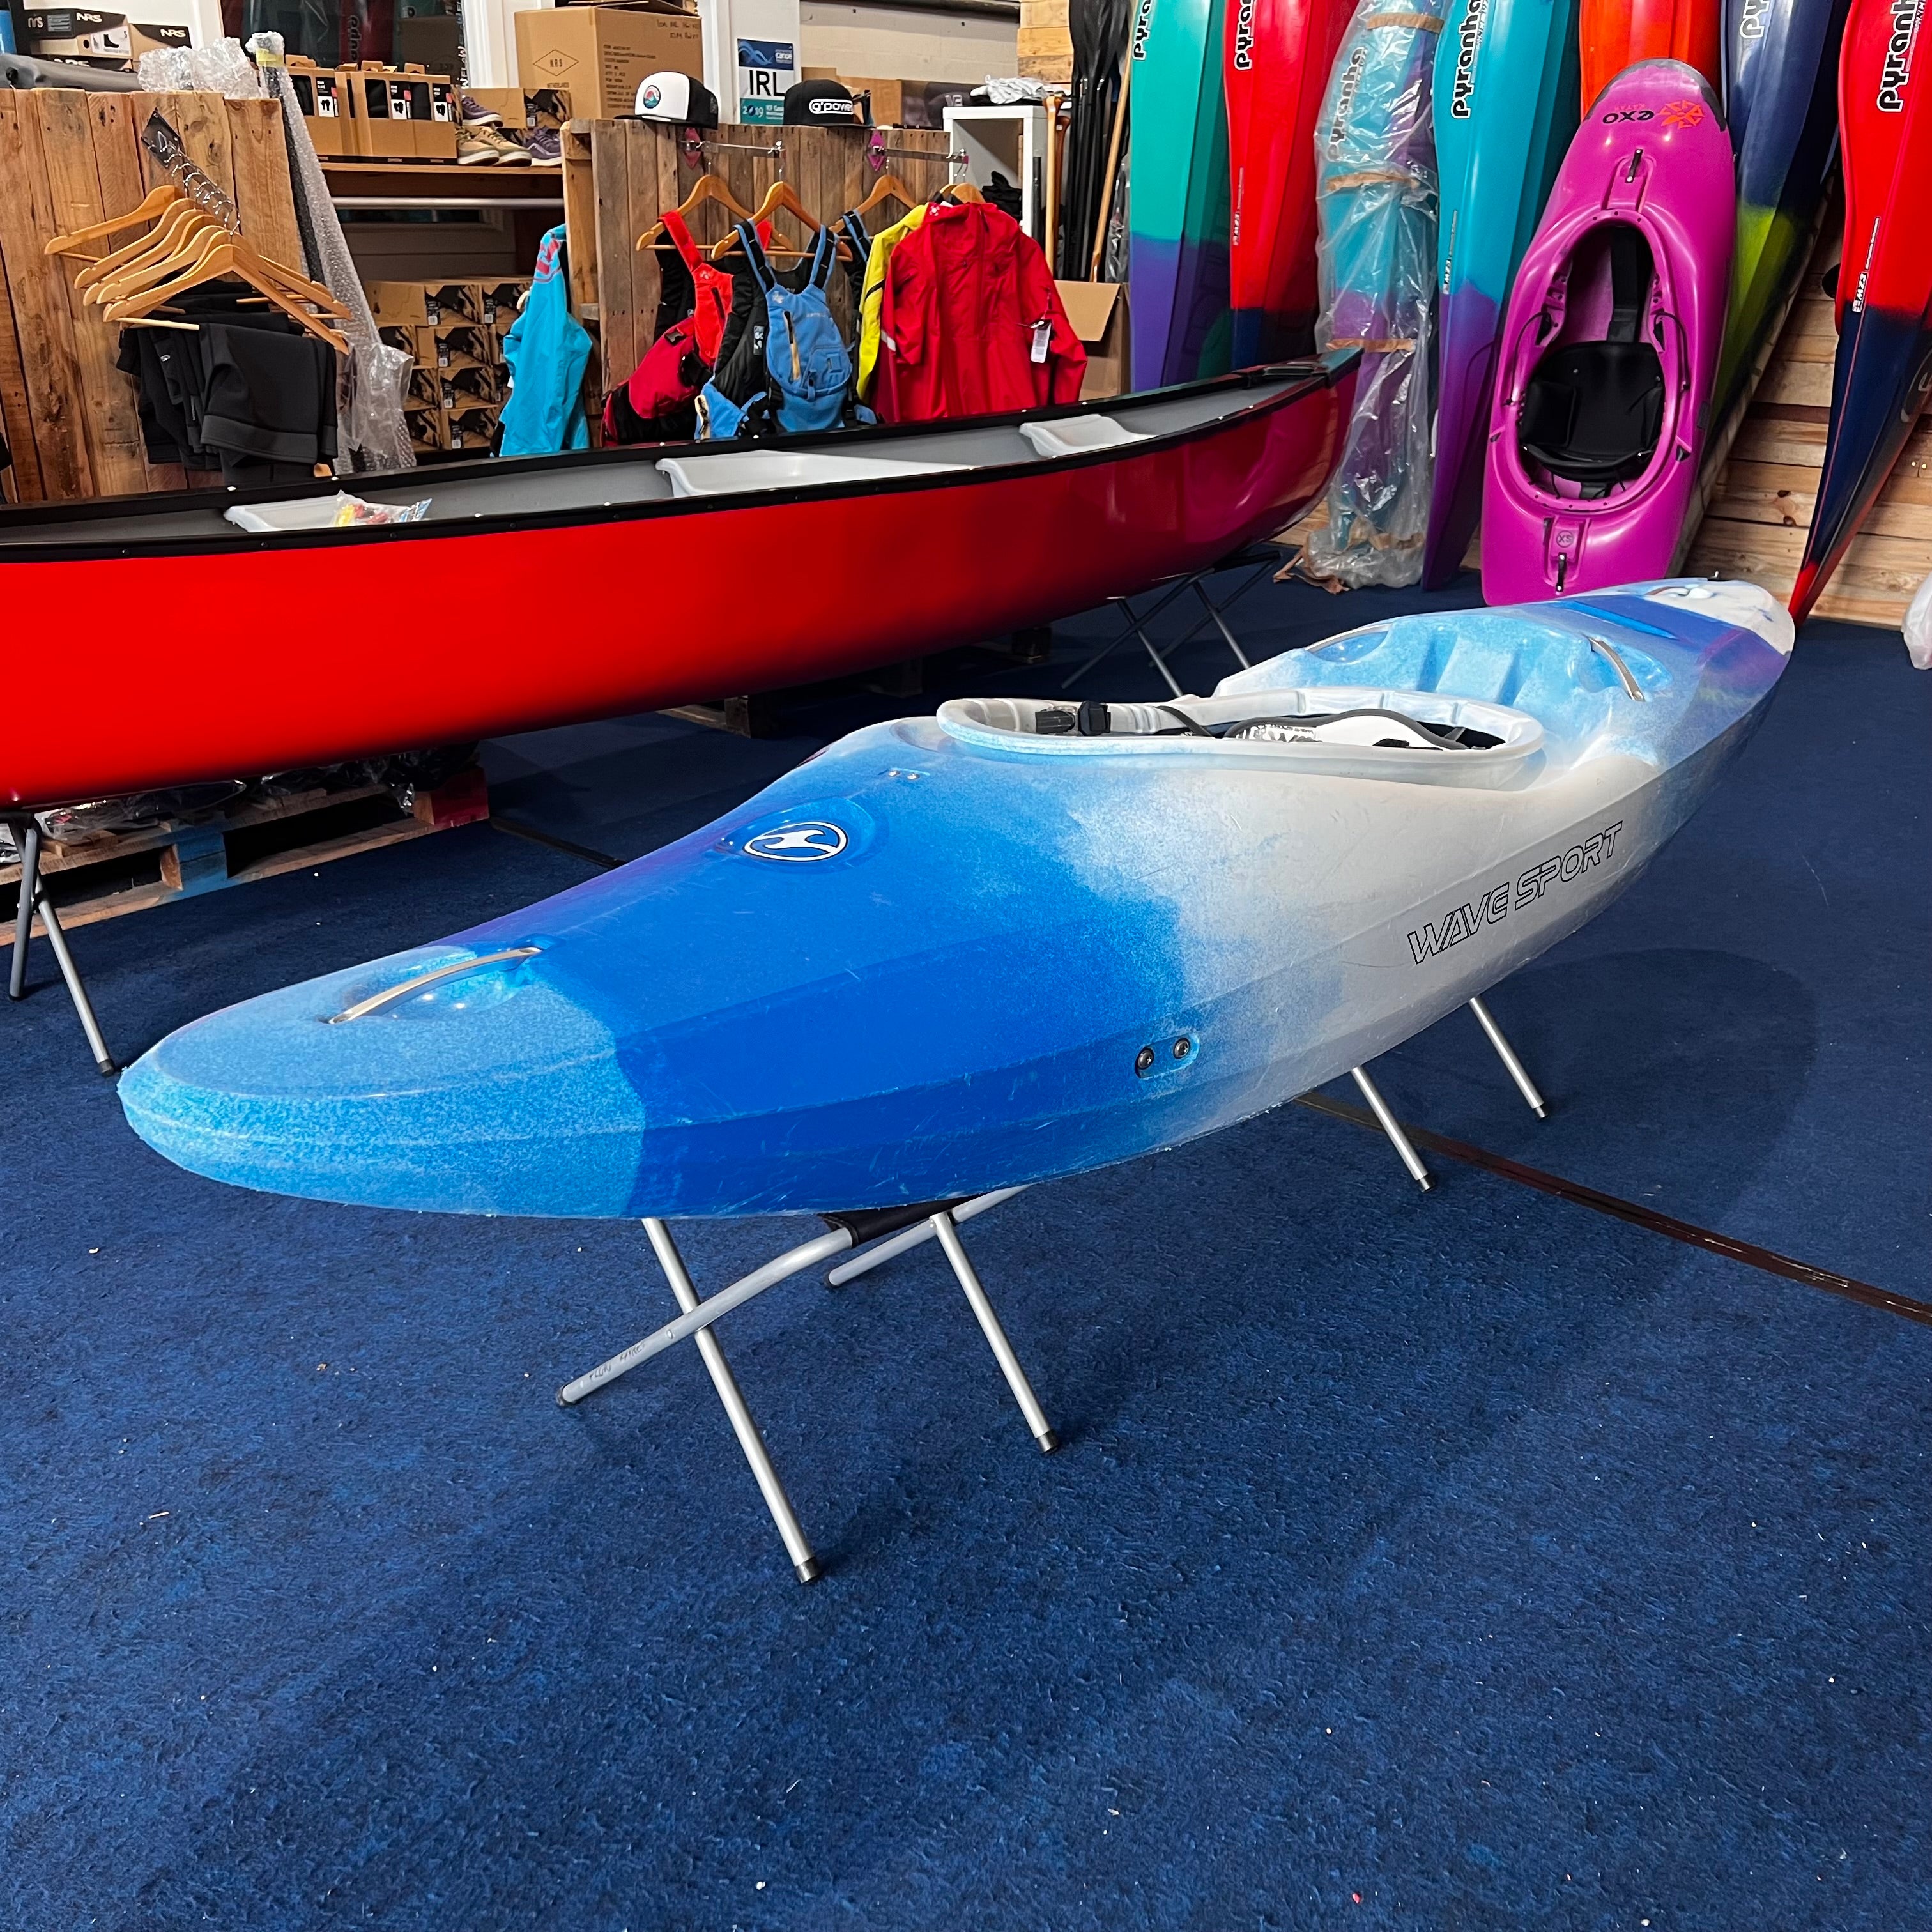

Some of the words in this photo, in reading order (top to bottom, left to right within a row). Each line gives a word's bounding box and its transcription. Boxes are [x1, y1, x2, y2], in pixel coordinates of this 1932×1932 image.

[76, 12, 102, 23] NRS
[160, 29, 186, 38] NRS
[1234, 0, 1255, 70] pyra
[1450, 0, 1483, 119] pyranha
[749, 70, 785, 96] IRL
[1326, 46, 1365, 162] pyranha
[1602, 110, 1655, 124] exo
[1855, 273, 1867, 300] MZ3
[1407, 882, 1510, 965] WAVE
[1515, 820, 1623, 911] SPORT
